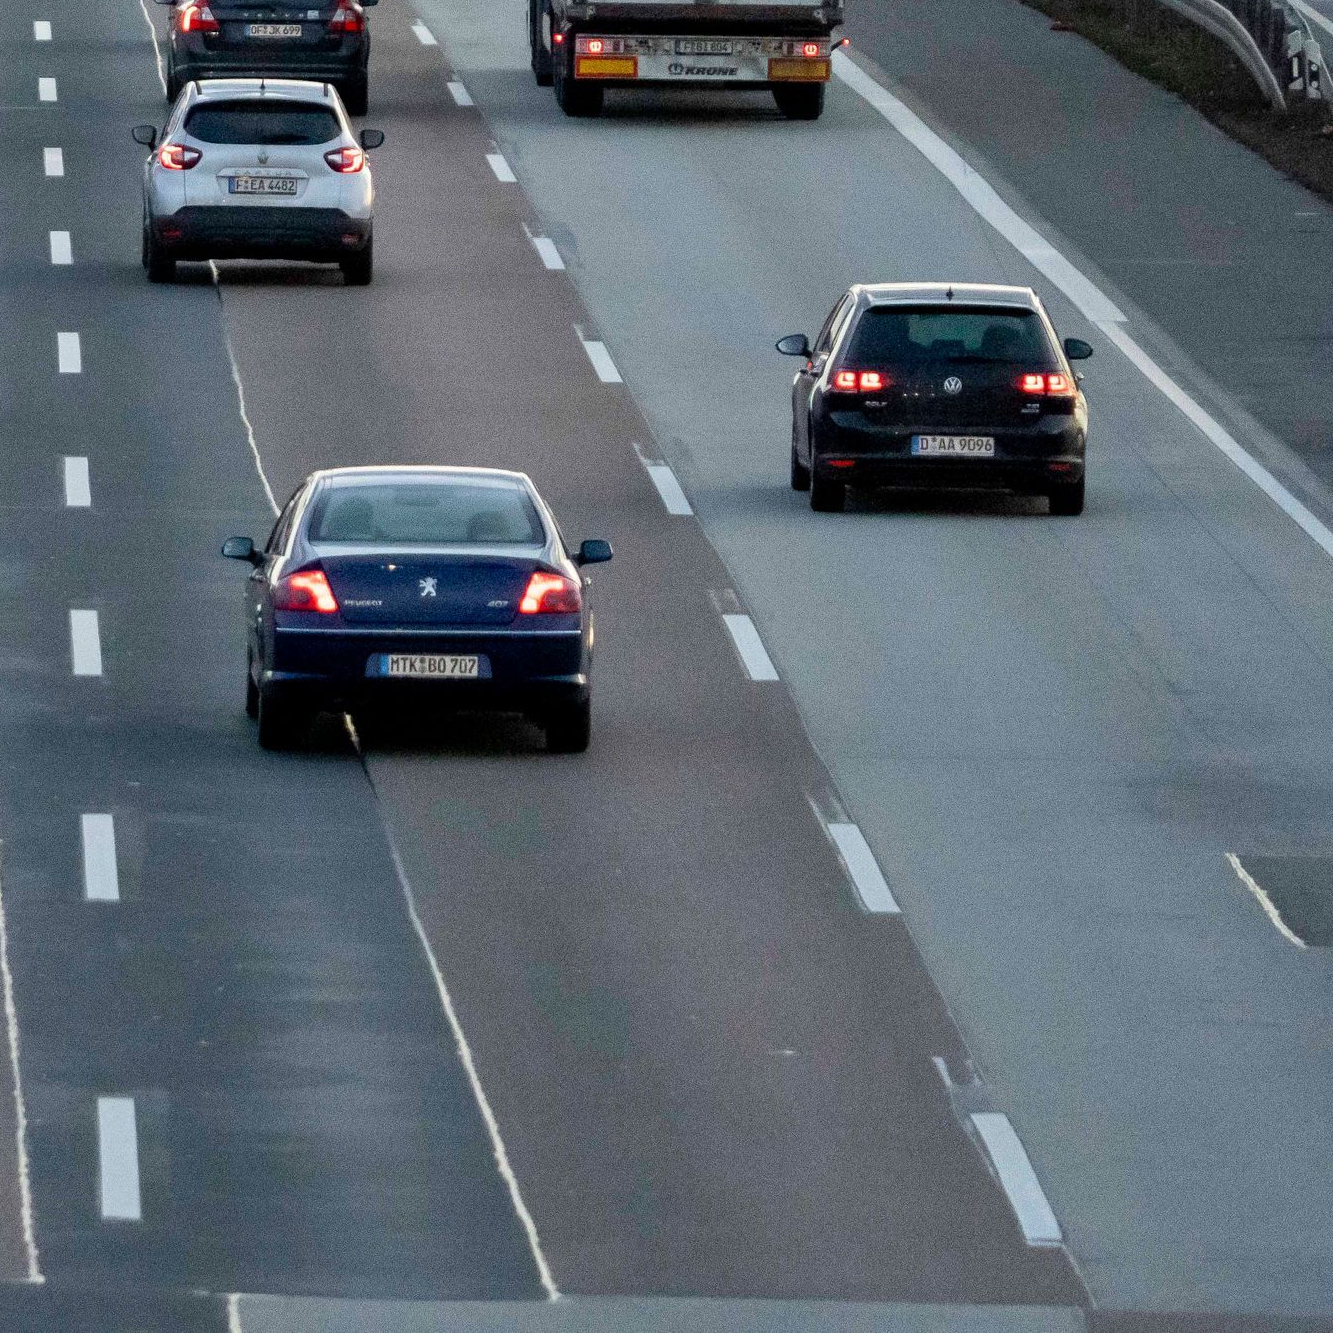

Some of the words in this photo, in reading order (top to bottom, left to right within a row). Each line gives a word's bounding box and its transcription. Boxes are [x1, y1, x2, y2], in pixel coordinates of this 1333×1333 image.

[684, 66, 739, 76] KRONE
[236, 179, 242, 190] F
[251, 179, 265, 190] EA
[268, 180, 295, 191] 4482
[919, 437, 929, 451] D
[938, 438, 956, 451] AA
[959, 438, 993, 452] 9096
[390, 657, 418, 674] MTK
[450, 658, 477, 674] 707
